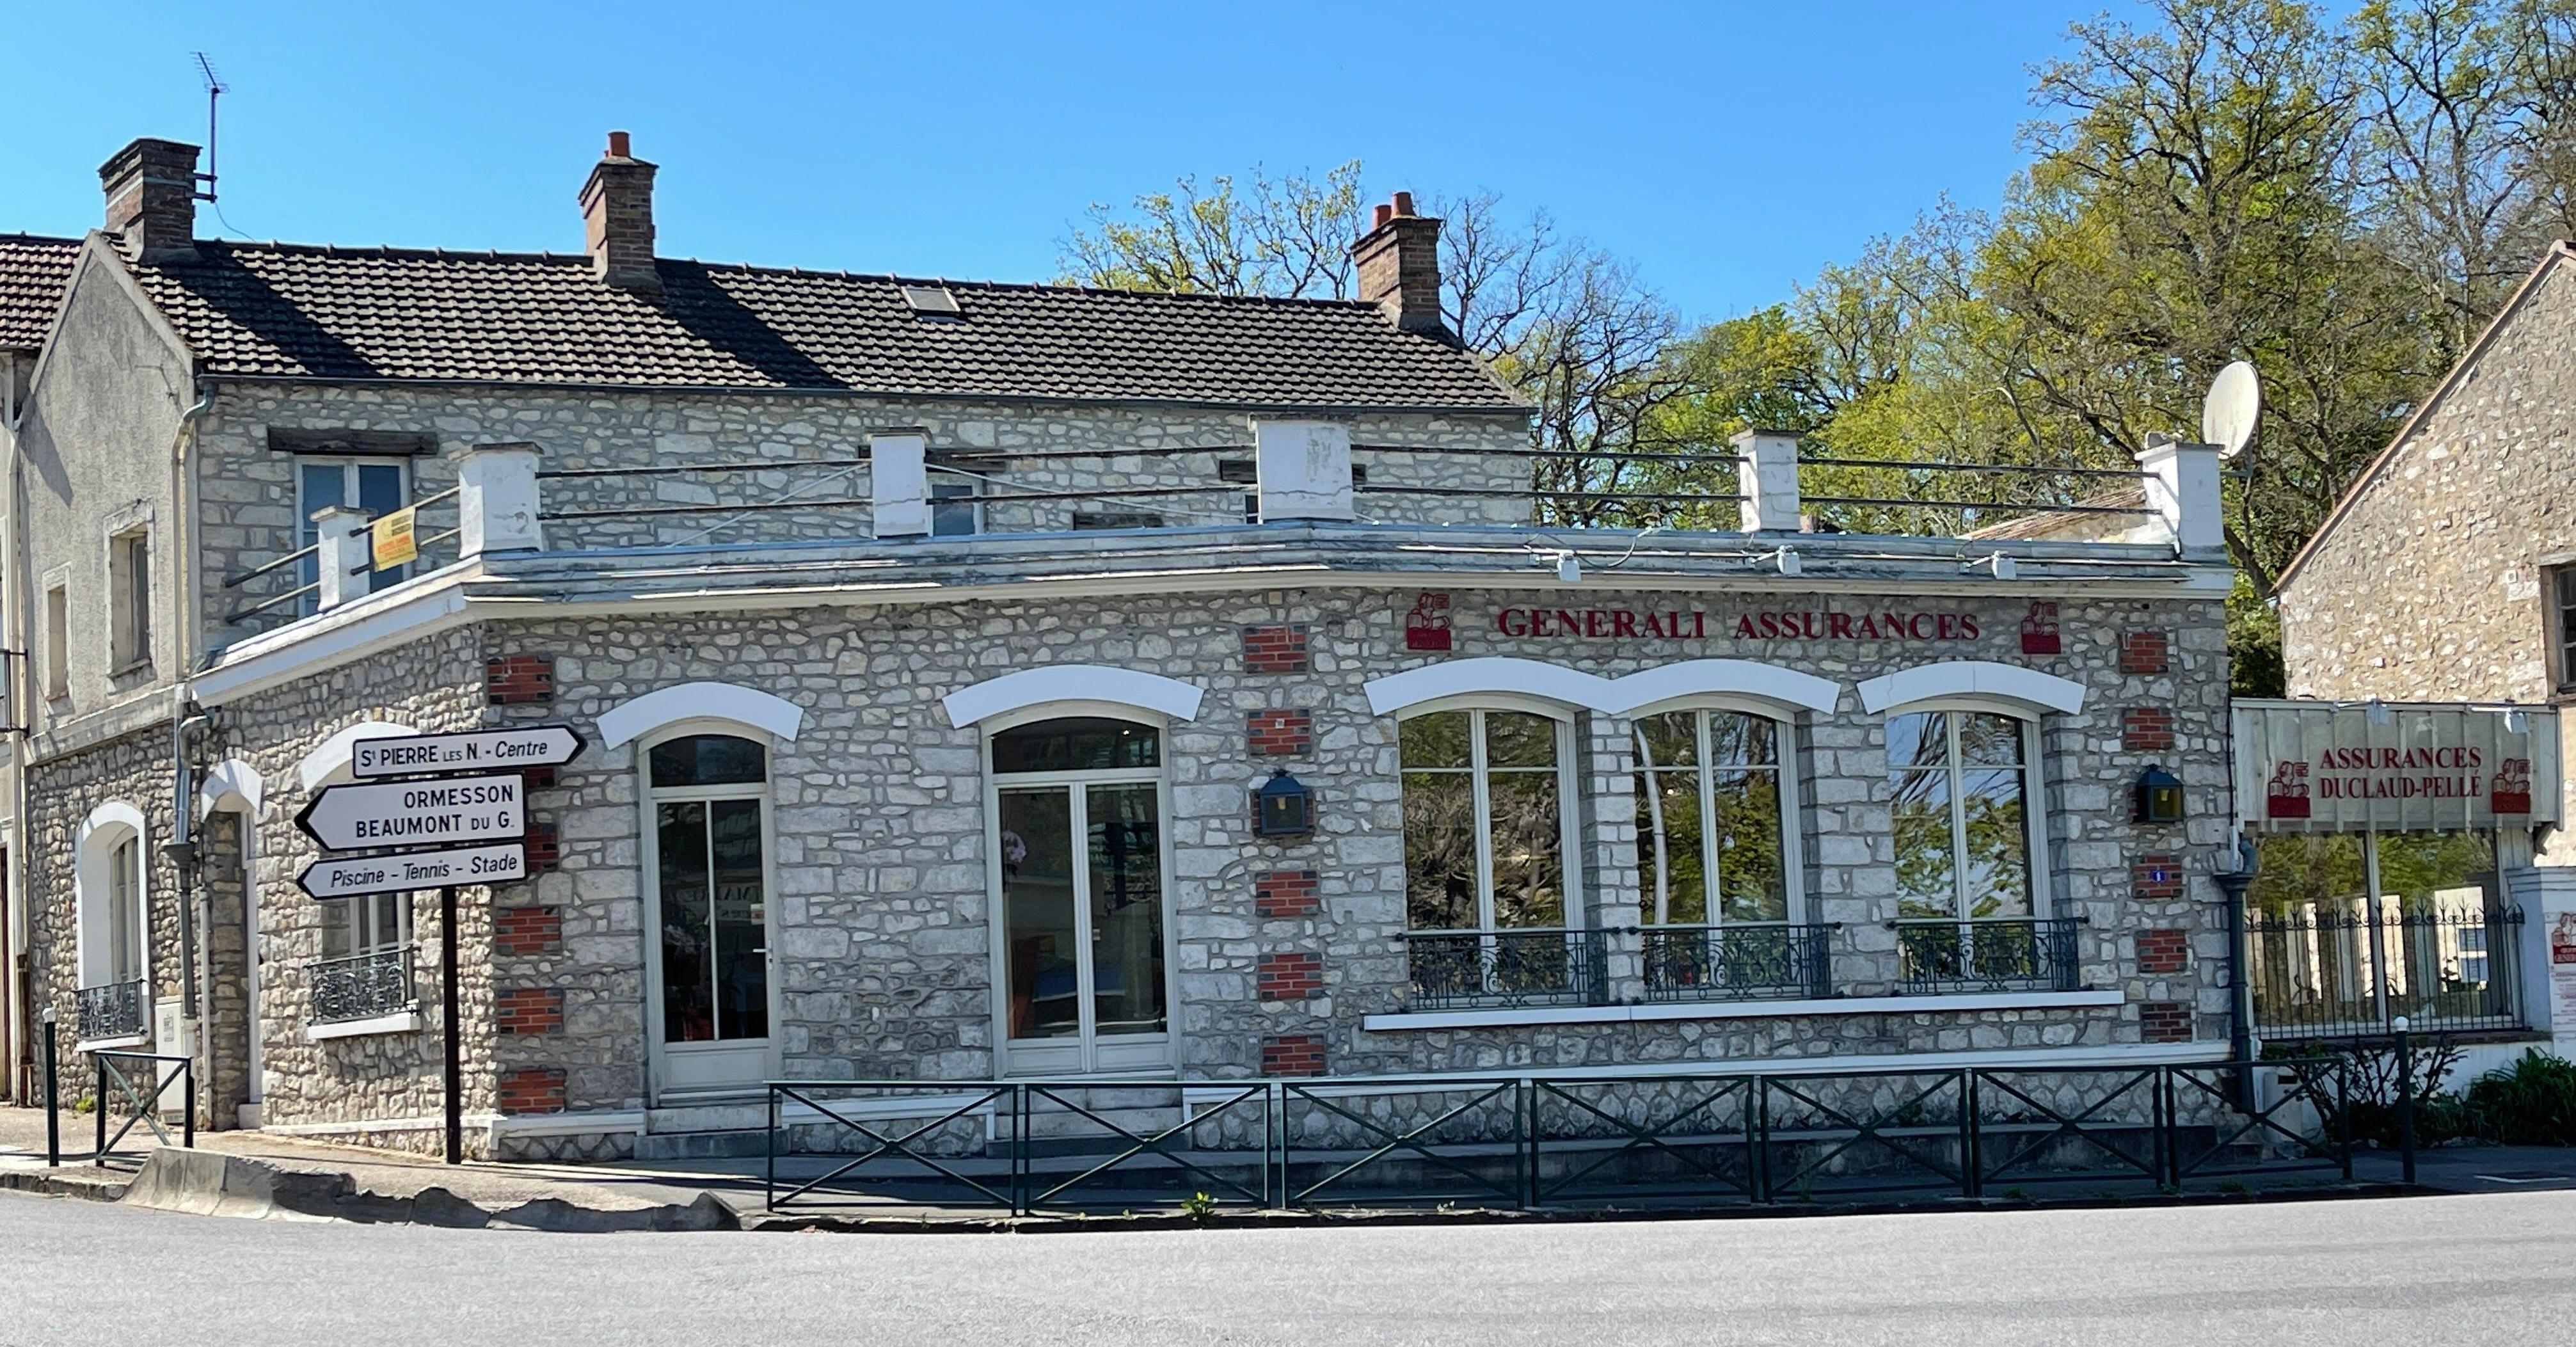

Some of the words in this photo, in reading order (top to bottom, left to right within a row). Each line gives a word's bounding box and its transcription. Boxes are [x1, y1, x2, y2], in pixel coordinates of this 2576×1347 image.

[1498, 609, 1706, 639] GENERALI
[1734, 612, 1979, 640] ASSURANCES
[380, 745, 438, 766] PIERRE
[443, 751, 462, 762] LES
[495, 740, 548, 758] Centre
[2320, 747, 2481, 769] ASSURANCES
[404, 785, 513, 808] ORMESSON
[2320, 769, 2483, 799] DUCLAUD-PELLÉ
[356, 814, 462, 838] BEAUMONT
[472, 817, 489, 831] DU
[330, 867, 384, 888] Piscine
[403, 859, 449, 881] Tennis
[471, 854, 517, 874] Stade
